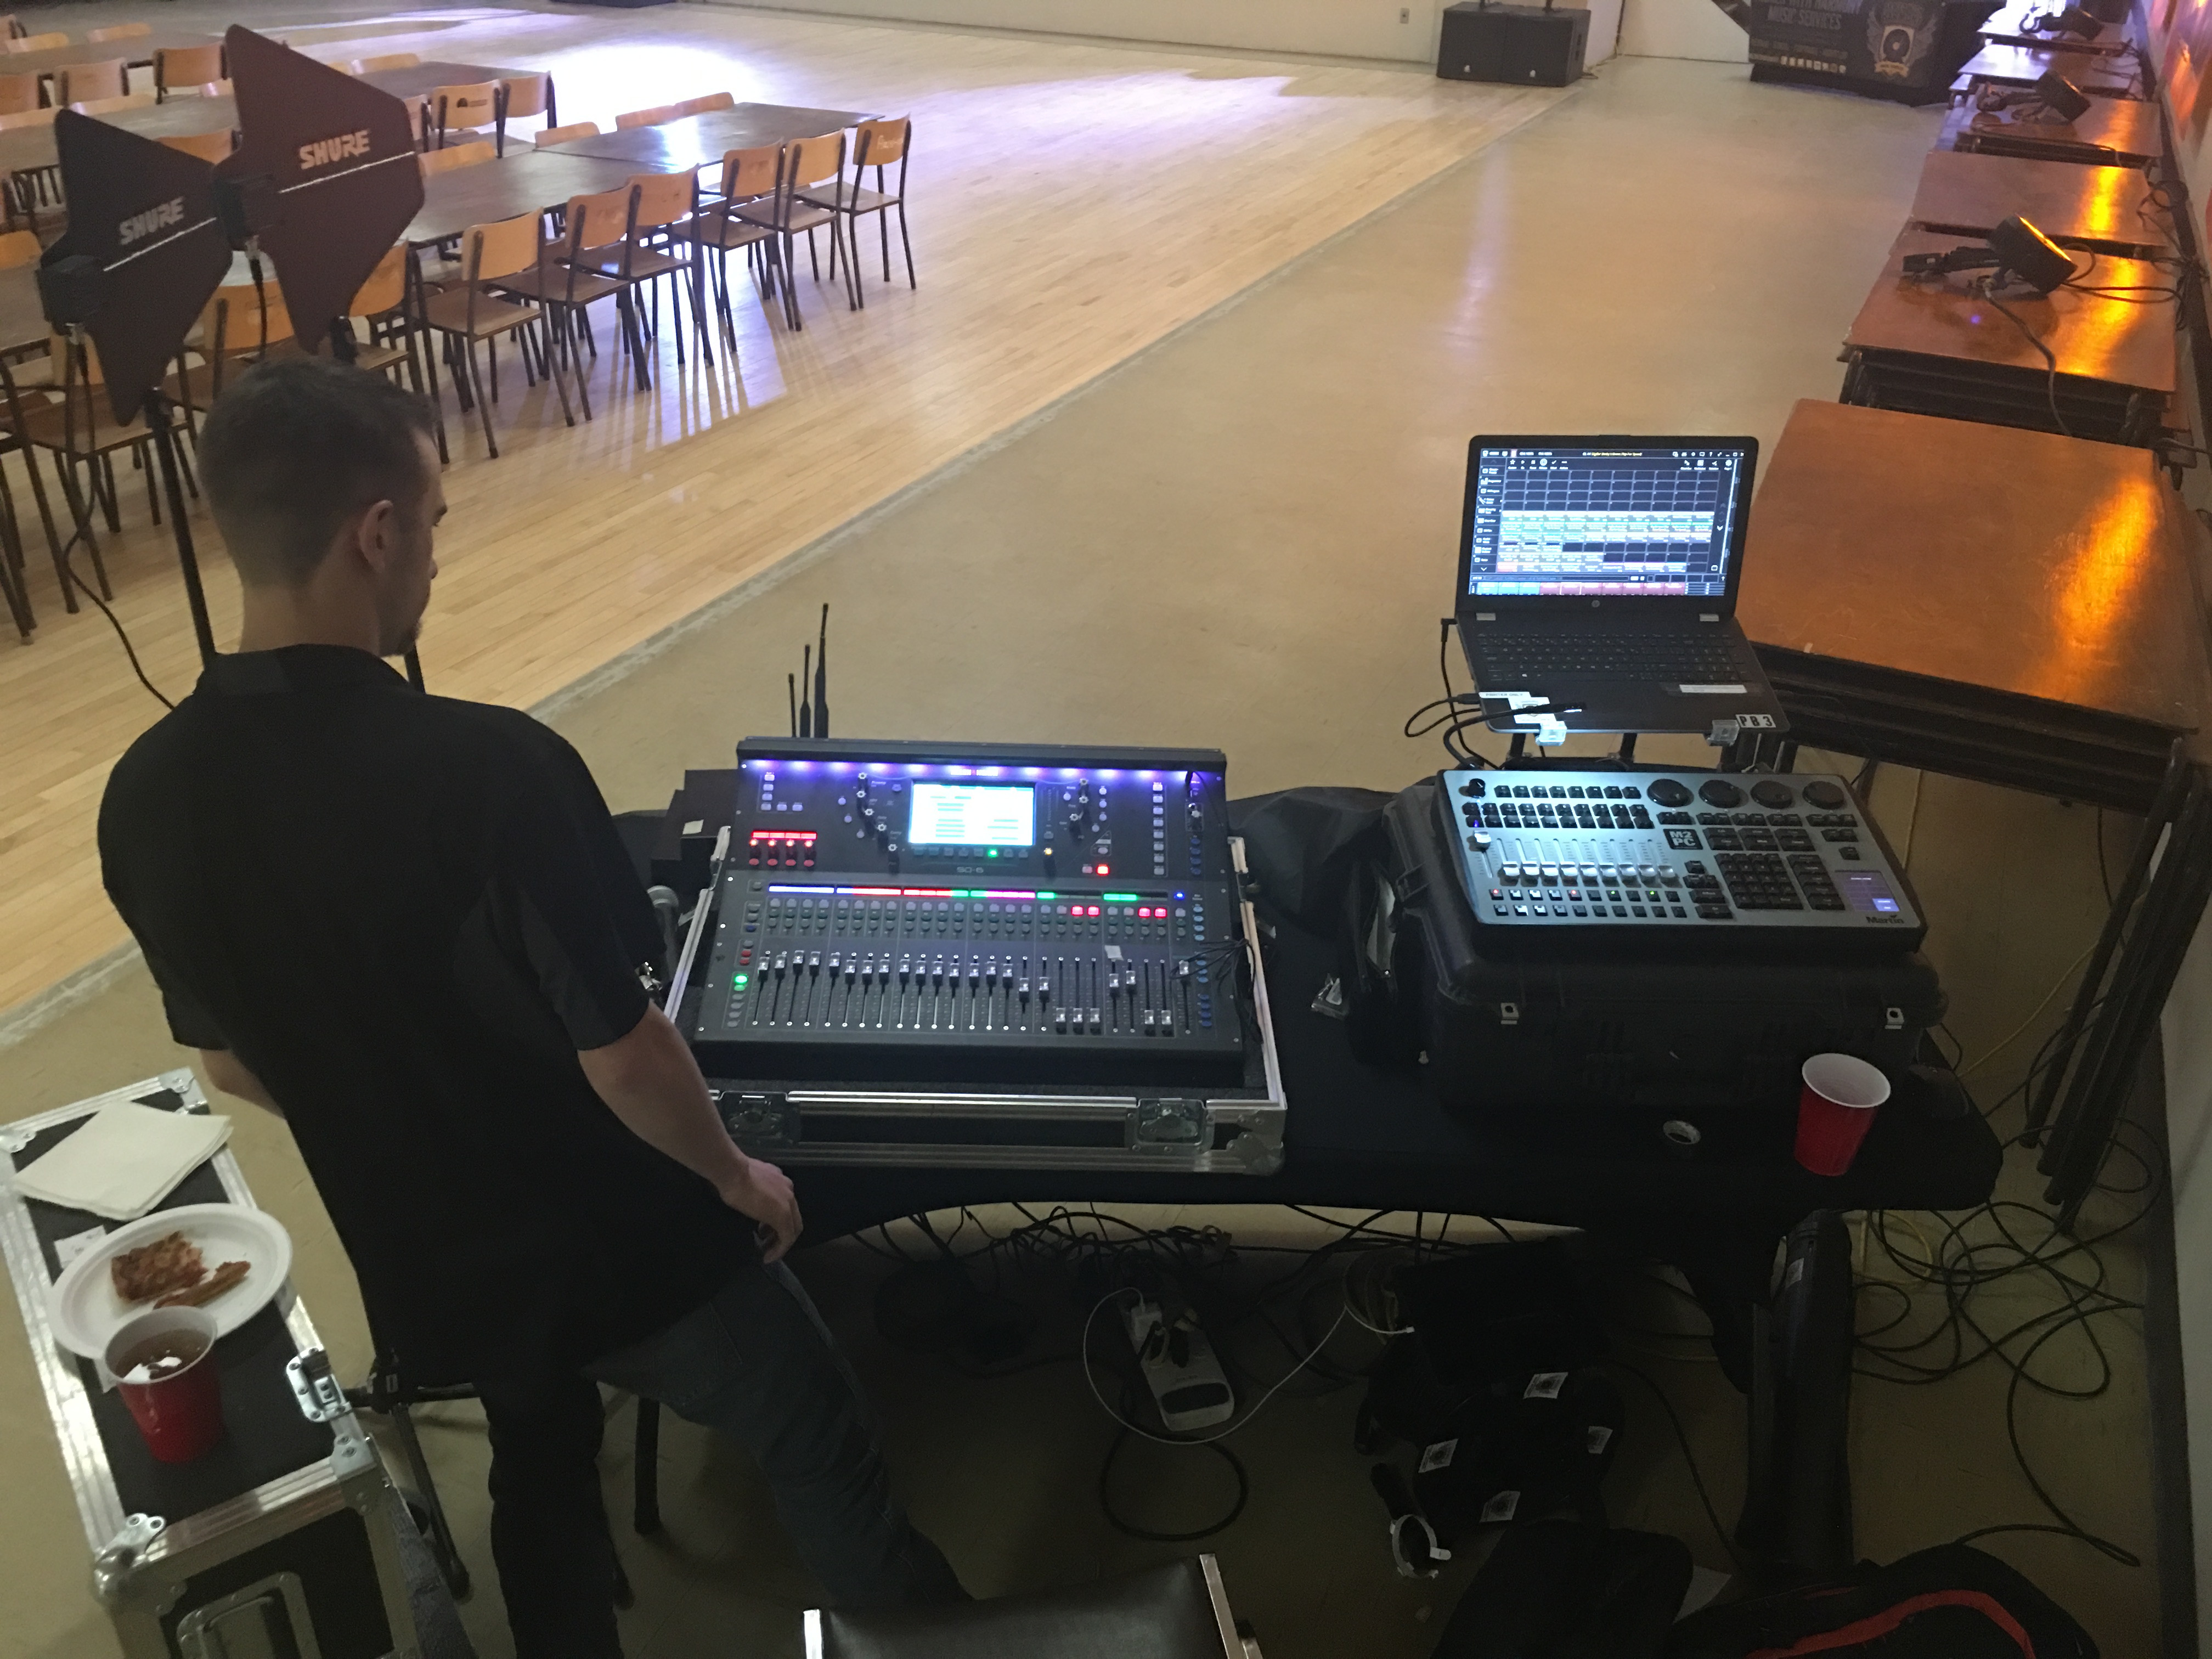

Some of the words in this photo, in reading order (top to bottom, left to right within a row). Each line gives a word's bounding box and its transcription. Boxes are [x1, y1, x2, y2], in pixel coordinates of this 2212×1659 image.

[1798, 9, 1842, 30] SERVICES
[299, 129, 370, 170] SHURE
[119, 196, 185, 245] SHURE
[1672, 838, 1696, 846] PC
[1865, 915, 1904, 924] Martin
